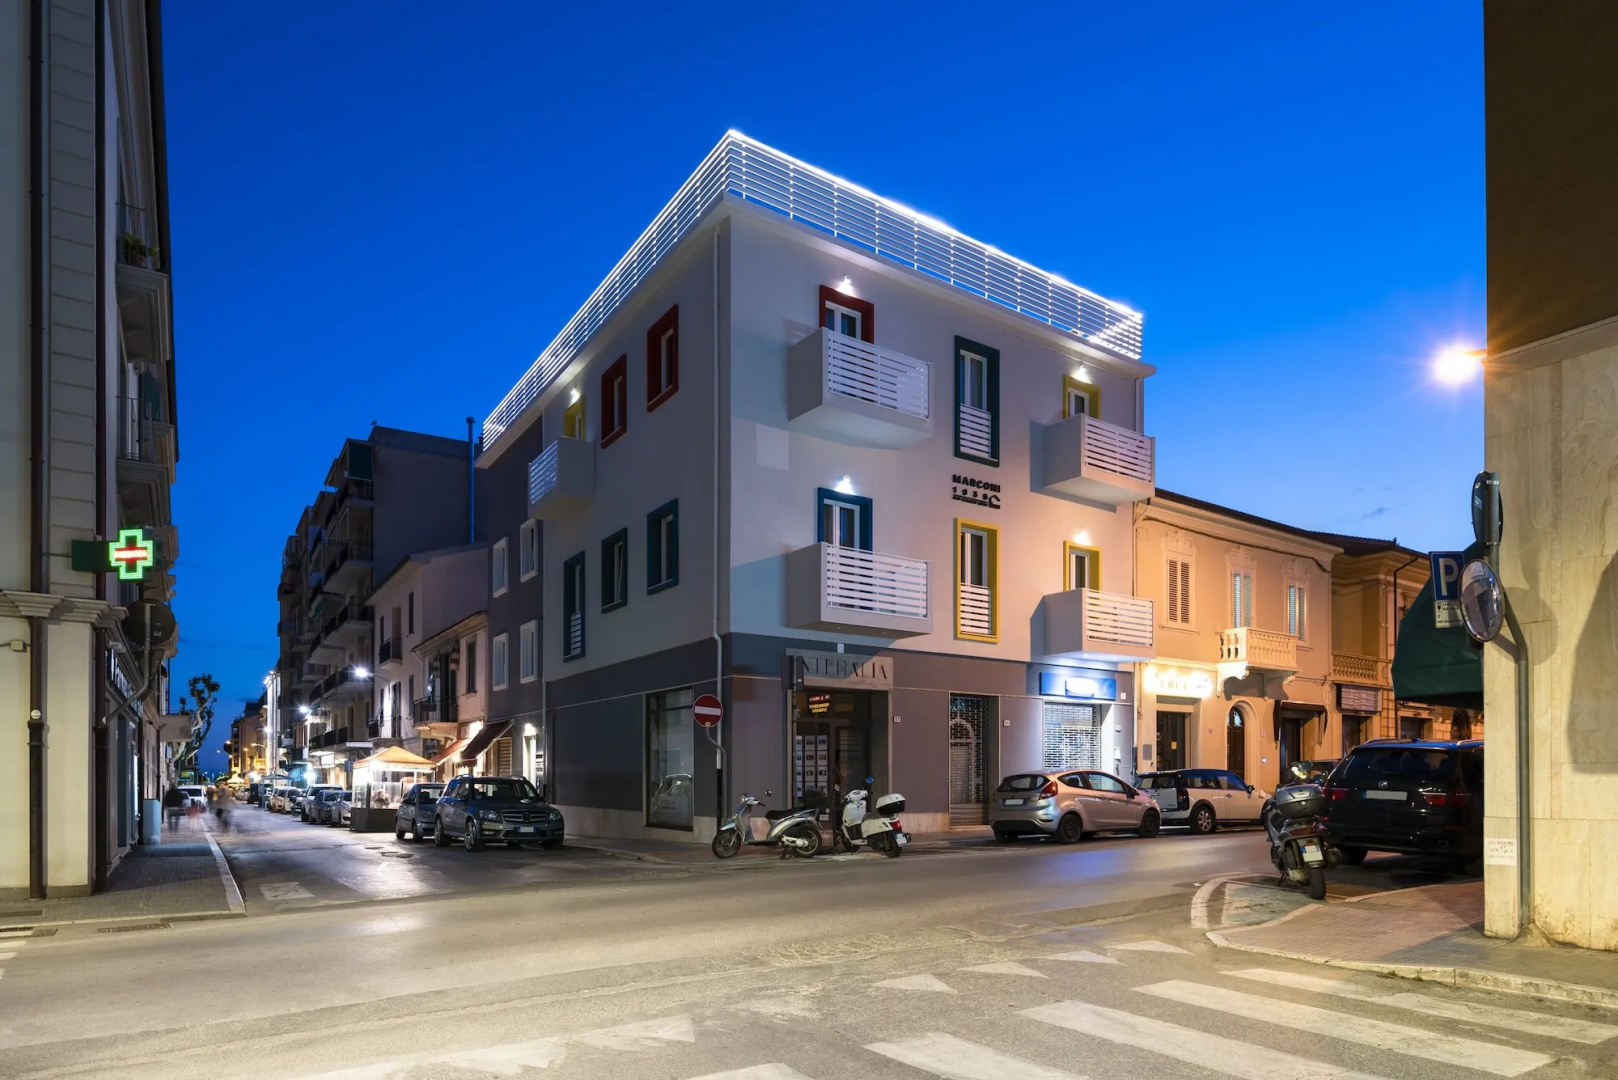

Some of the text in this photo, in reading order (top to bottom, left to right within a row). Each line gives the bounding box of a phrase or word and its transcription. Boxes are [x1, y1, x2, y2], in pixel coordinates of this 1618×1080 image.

[952, 474, 1000, 493] MARCONI
[1439, 557, 1458, 596] P
[800, 655, 887, 680] NTERALIA
